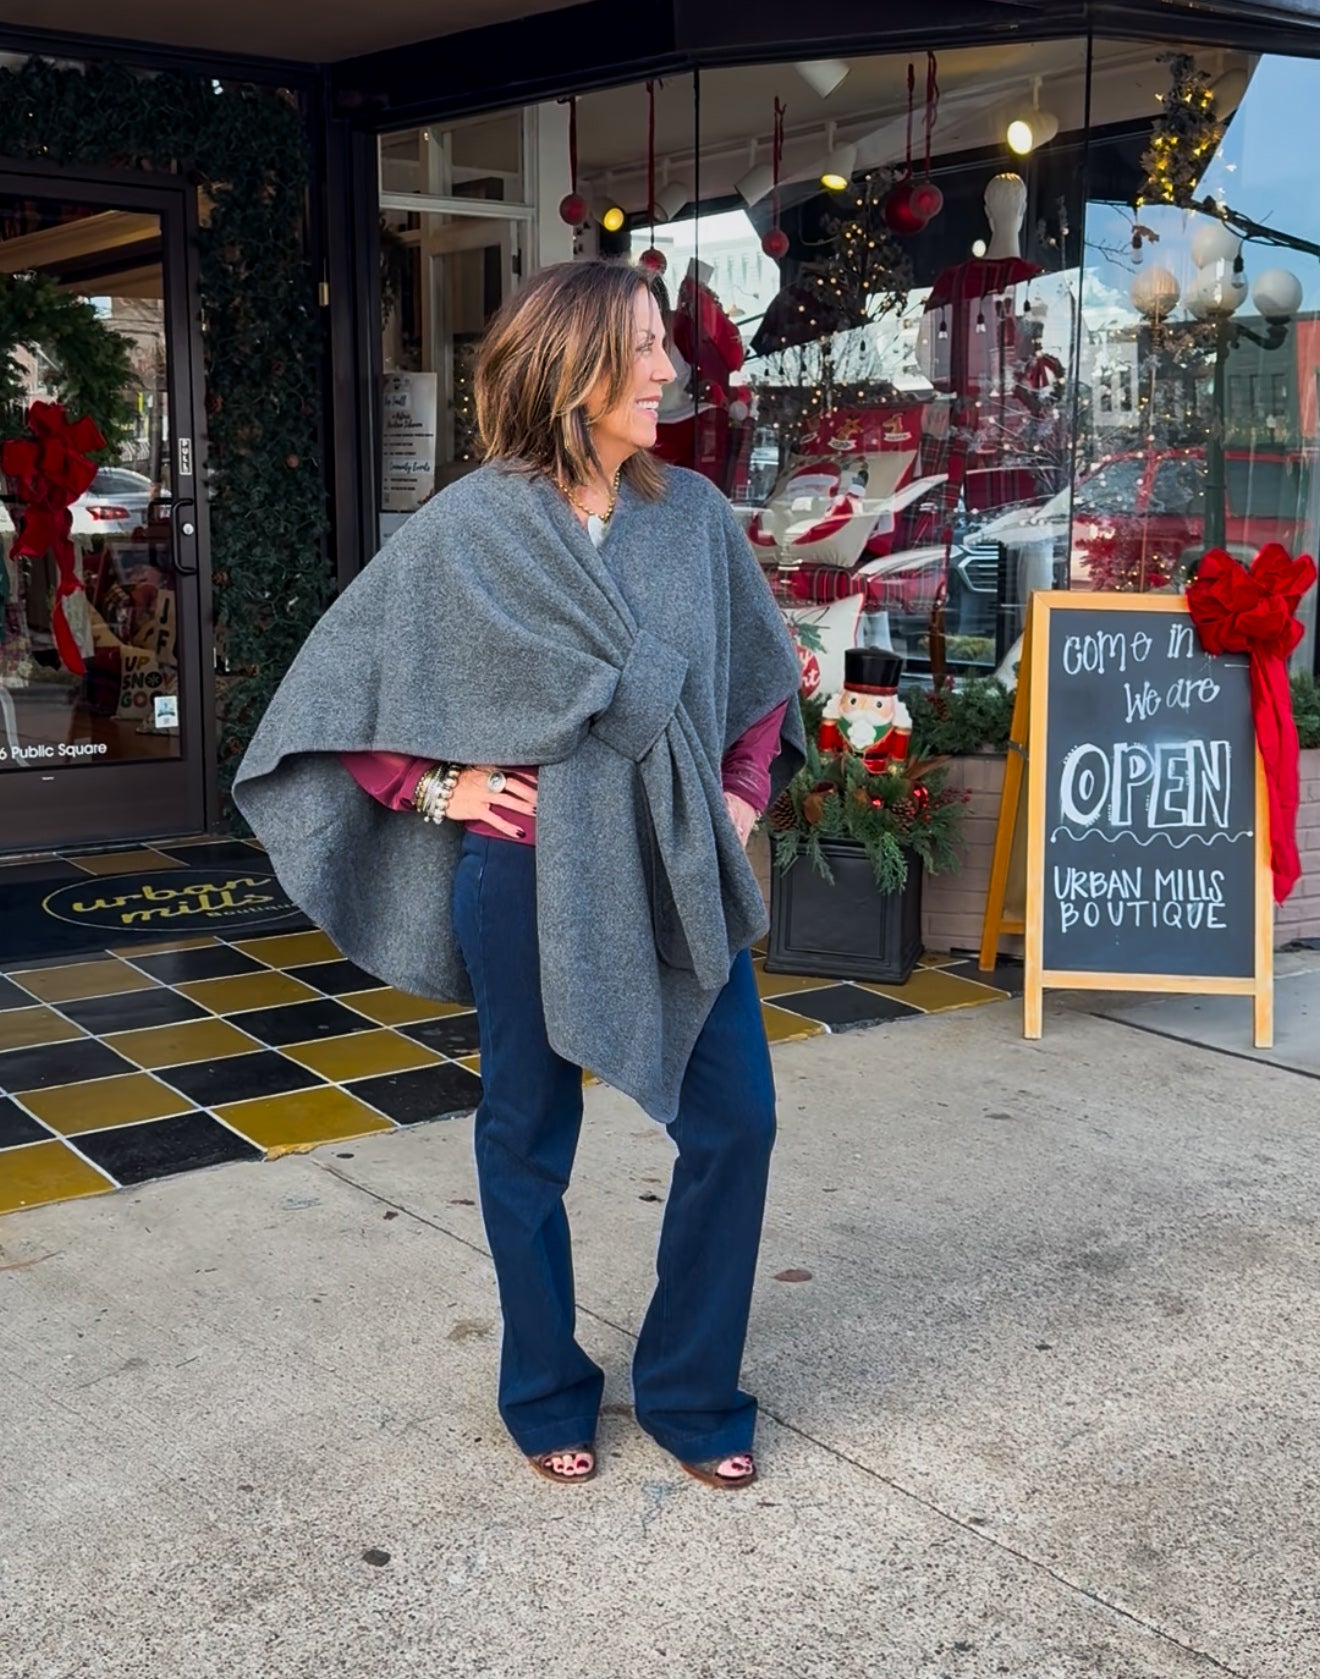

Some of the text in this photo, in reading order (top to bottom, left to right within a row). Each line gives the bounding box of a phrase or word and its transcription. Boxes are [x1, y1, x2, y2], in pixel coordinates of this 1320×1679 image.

[125, 655, 150, 672] UP
[1166, 677, 1220, 710] are
[11, 745, 55, 759] Public
[57, 743, 108, 758] Square
[1060, 740, 1231, 828] OPEN
[72, 877, 272, 912] urban
[1054, 866, 1226, 902] URBAN MILLS
[121, 890, 274, 924] mills
[1061, 901, 1227, 933] BOUTIQUE
